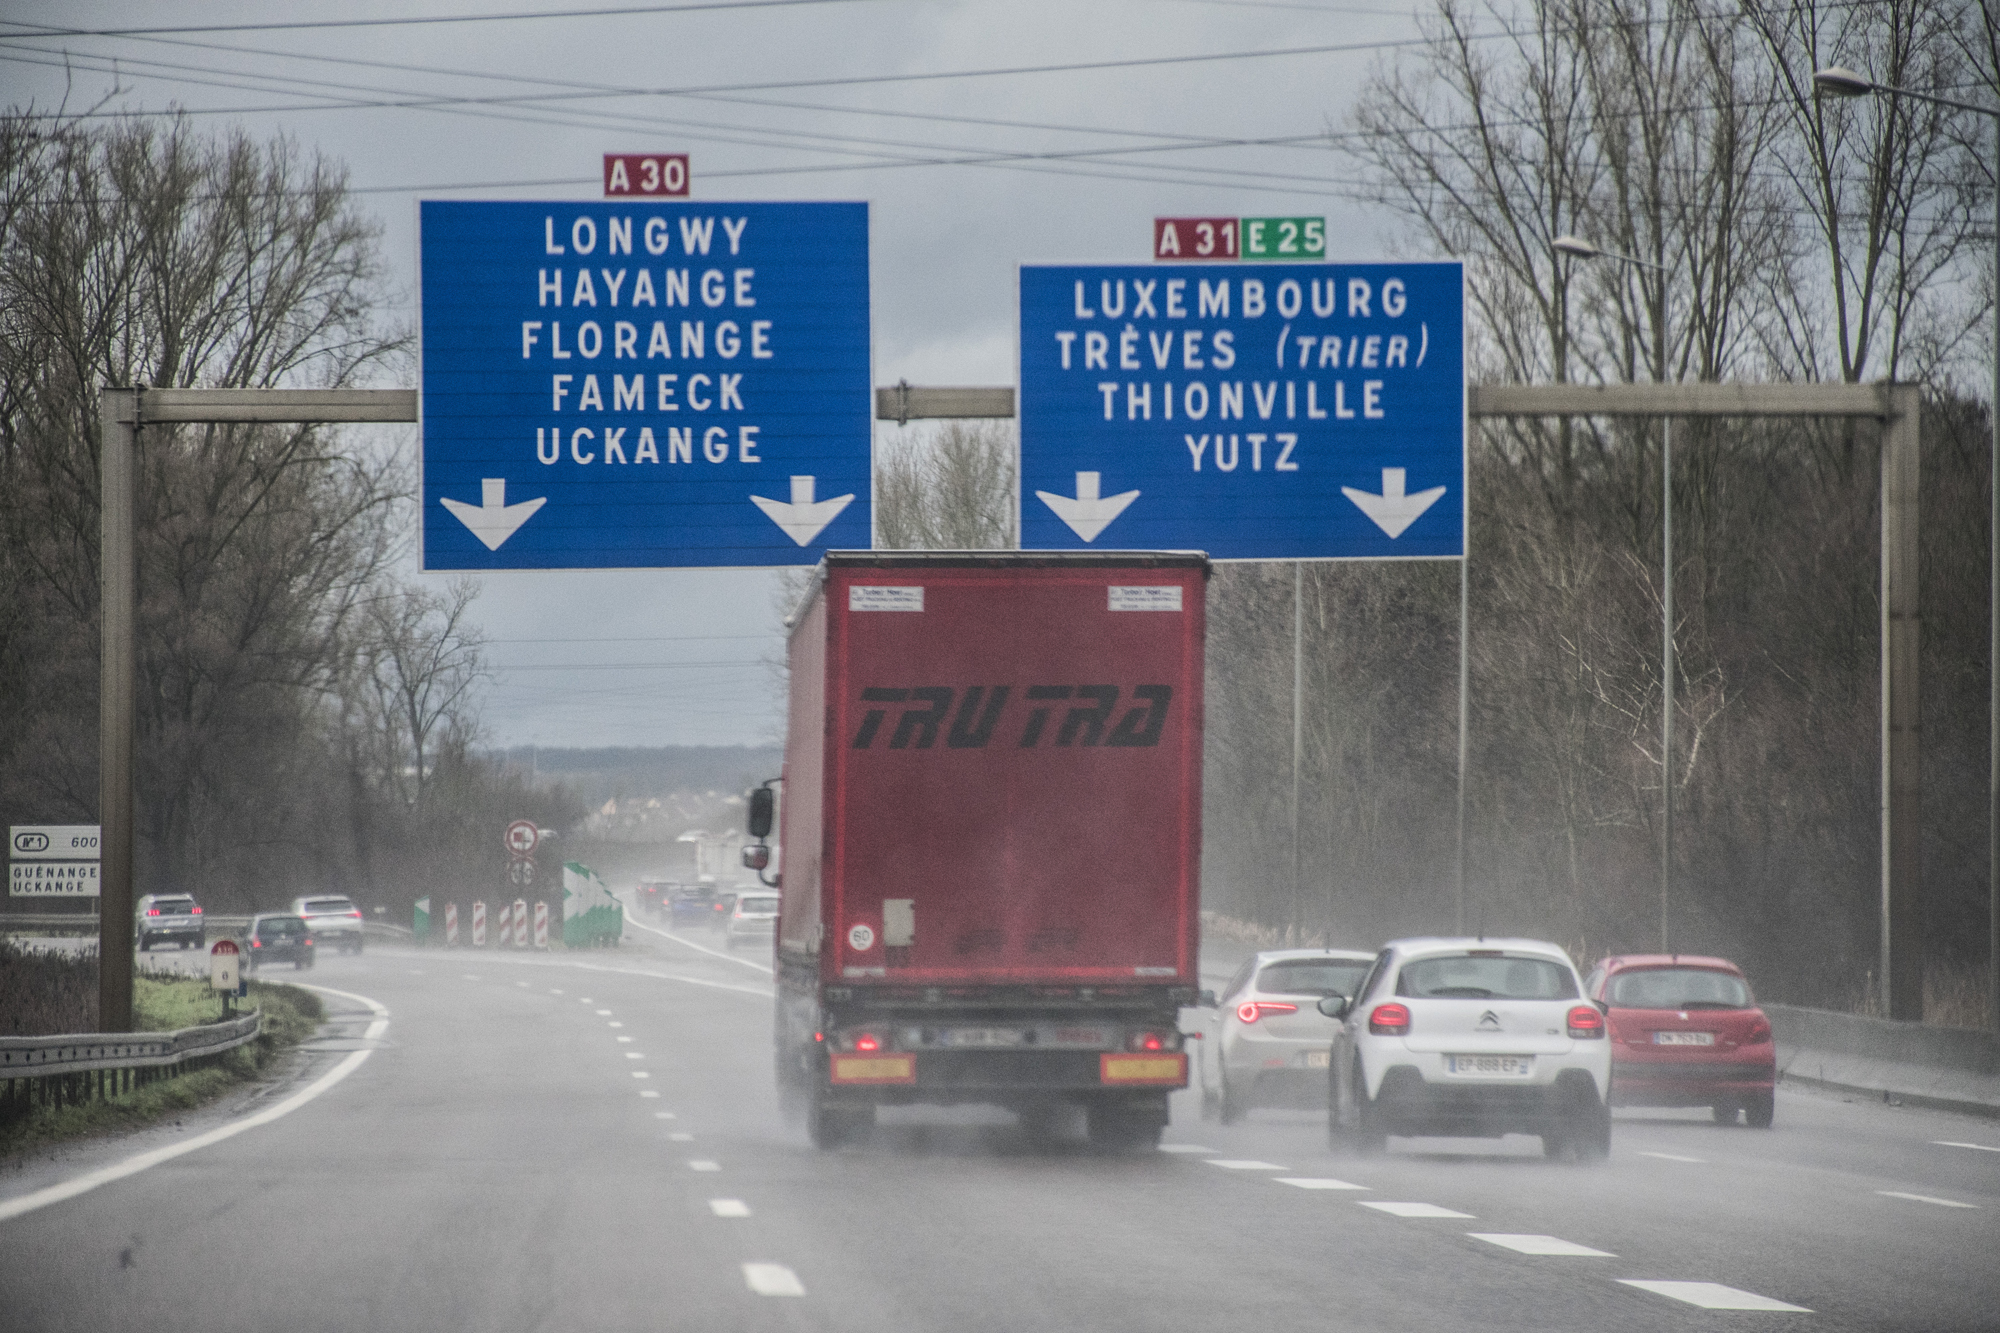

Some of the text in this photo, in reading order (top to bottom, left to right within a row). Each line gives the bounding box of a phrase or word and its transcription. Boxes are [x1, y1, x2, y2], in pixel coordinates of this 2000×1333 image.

[609, 158, 685, 192] A 30
[545, 216, 748, 256] LONGWY
[1159, 222, 1235, 255] A 31
[1249, 221, 1325, 253] E 25
[538, 269, 756, 308] HAYANGE
[1074, 278, 1407, 319] LUXEMBOURG
[522, 320, 773, 359] FLORANGE
[1055, 322, 1428, 370] TRÈVES (TRIER)
[552, 373, 744, 412] FAMECK
[1098, 380, 1384, 420] THIONVILLE
[536, 426, 761, 465] UCKANGE
[1185, 433, 1299, 472] YUTZ
[71, 837, 98, 848] 600
[13, 865, 97, 879] GUÉNANGE
[13, 881, 84, 893] UCKANGE
